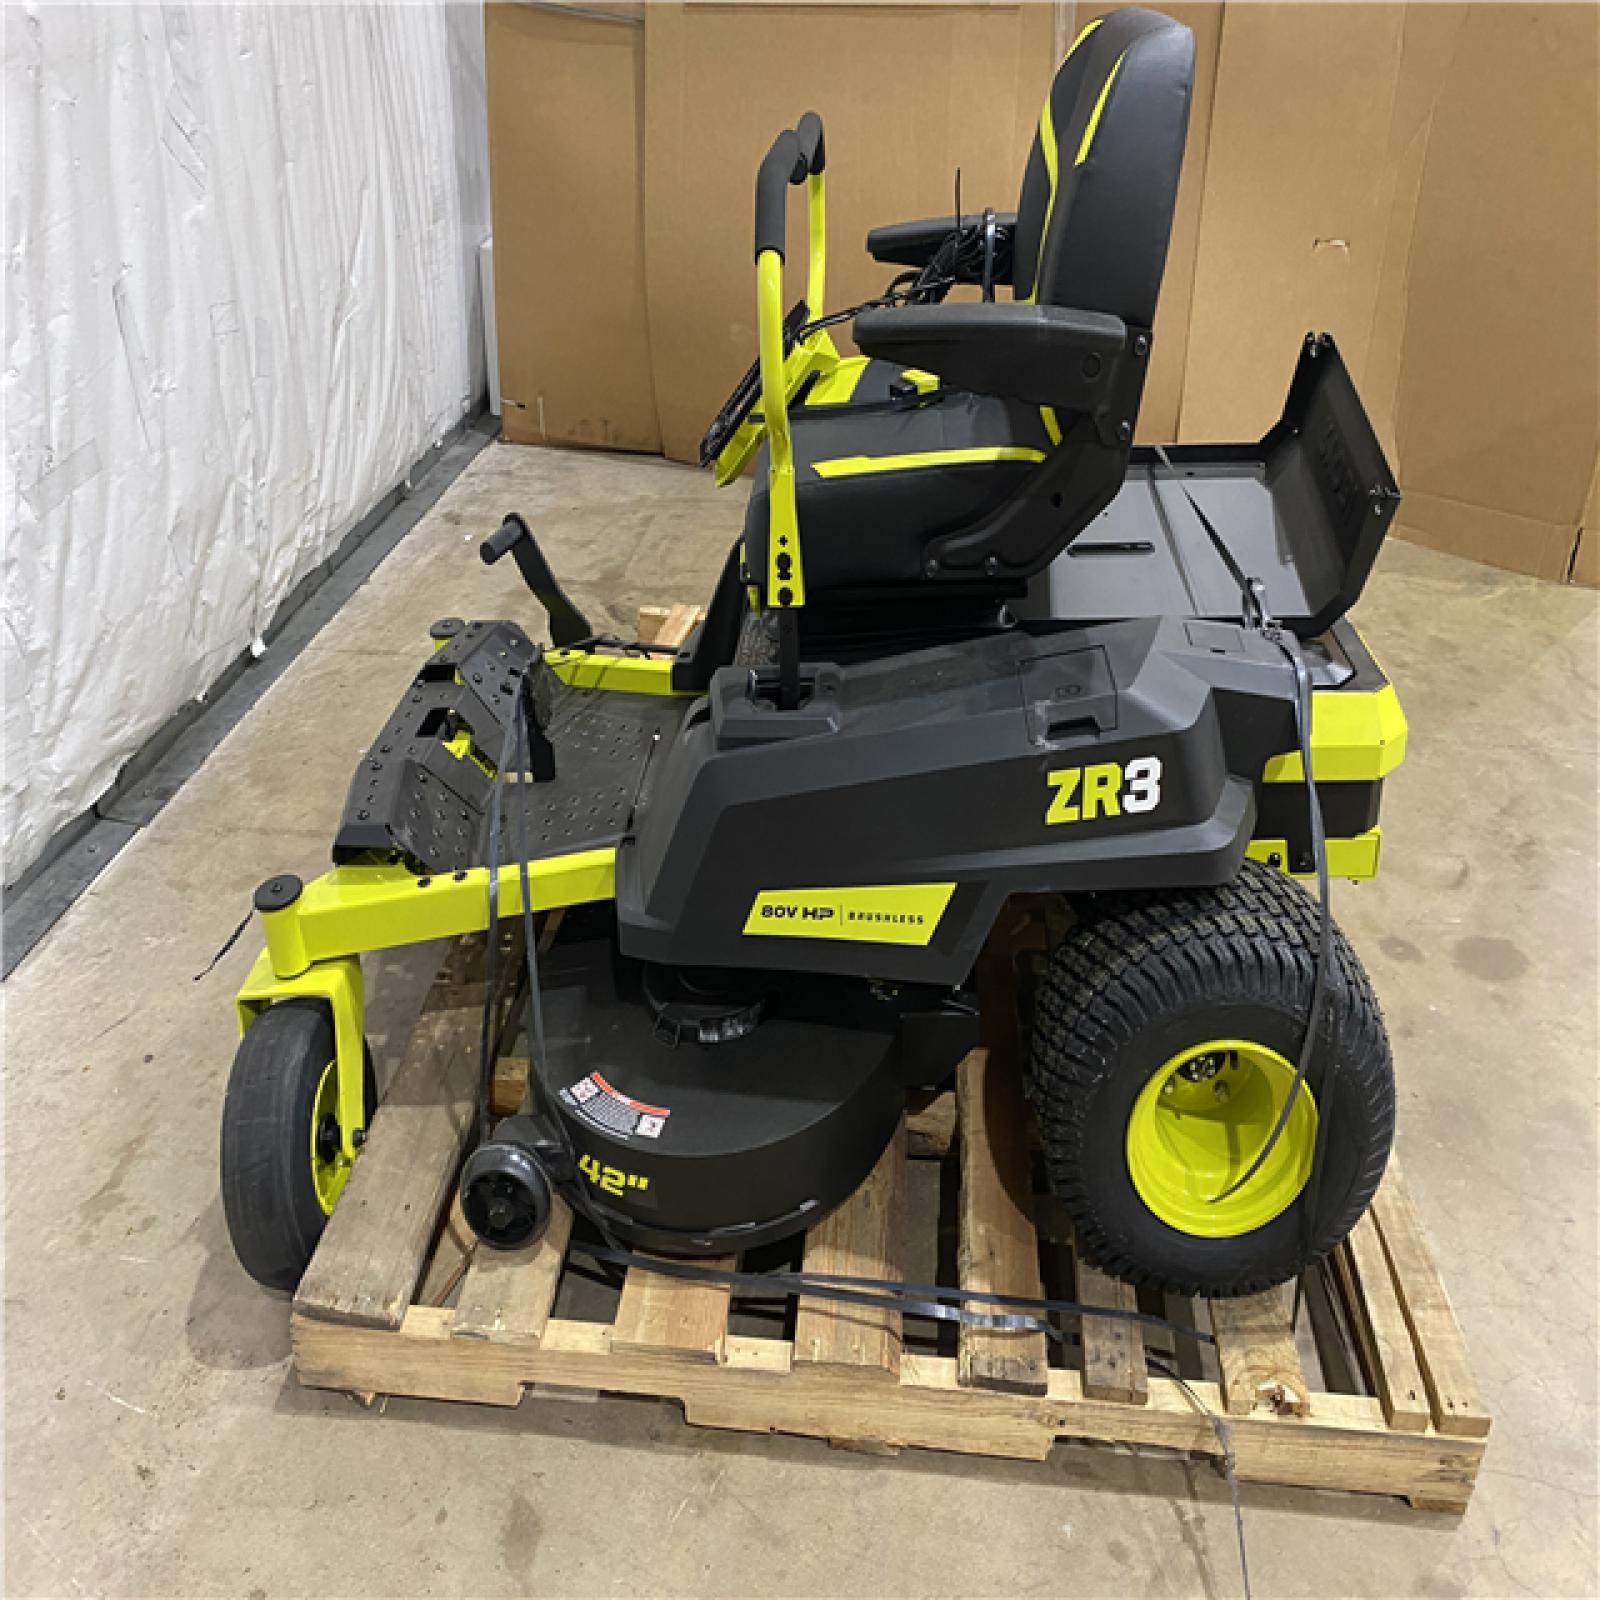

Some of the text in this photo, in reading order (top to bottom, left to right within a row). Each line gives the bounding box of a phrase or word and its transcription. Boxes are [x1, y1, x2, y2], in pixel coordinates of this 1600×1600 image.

[1045, 757, 1162, 824] ZR3
[761, 904, 798, 918] 80V
[802, 906, 834, 920] HP
